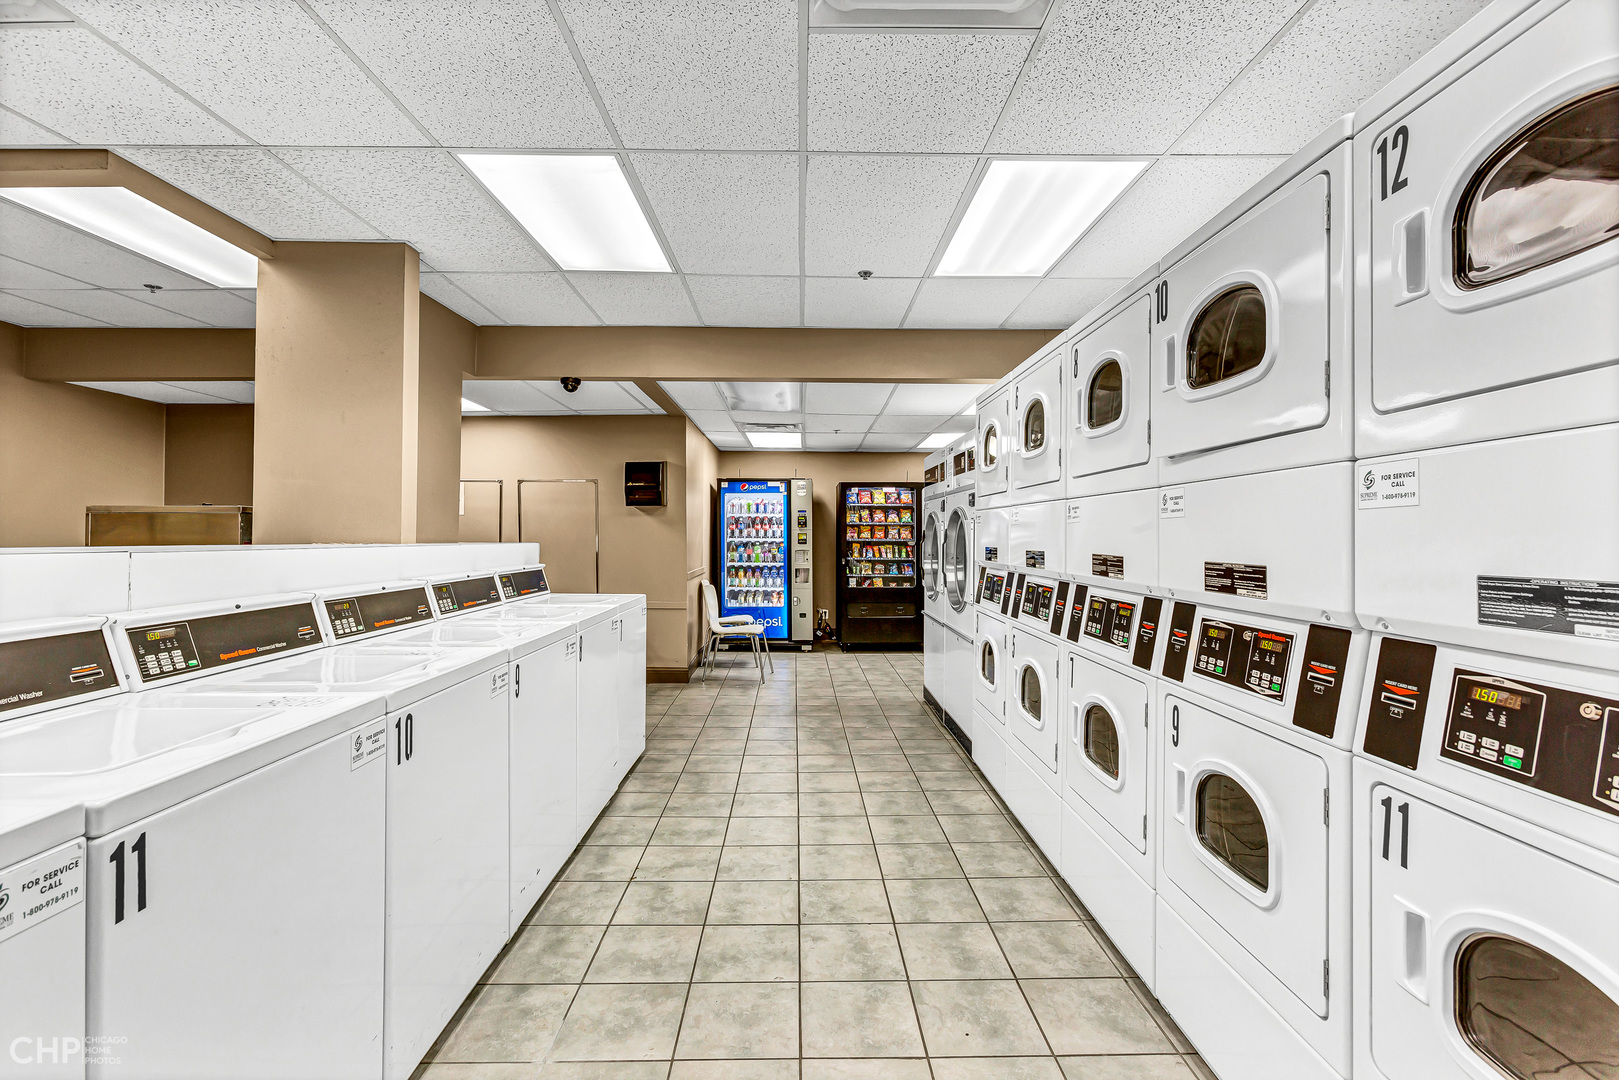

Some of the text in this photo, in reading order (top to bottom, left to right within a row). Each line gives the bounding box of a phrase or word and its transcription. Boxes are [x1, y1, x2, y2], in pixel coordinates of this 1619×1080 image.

[1377, 125, 1409, 201] 12
[1155, 280, 1168, 324] 10
[1073, 348, 1079, 379] 8
[749, 483, 767, 491] pepsi
[1393, 471, 1416, 480] SERVICE
[752, 616, 782, 629] epsi
[219, 650, 239, 660] Speed
[19, 690, 44, 701] Washer
[515, 664, 520, 698] 9
[395, 713, 413, 766] 10
[1172, 704, 1179, 748] 9
[1381, 796, 1409, 869] 11
[21, 859, 80, 893] FOR SERVICE
[40, 878, 63, 895] CALL
[109, 831, 147, 925] 11
[22, 886, 79, 919] 1-800-978-9119
